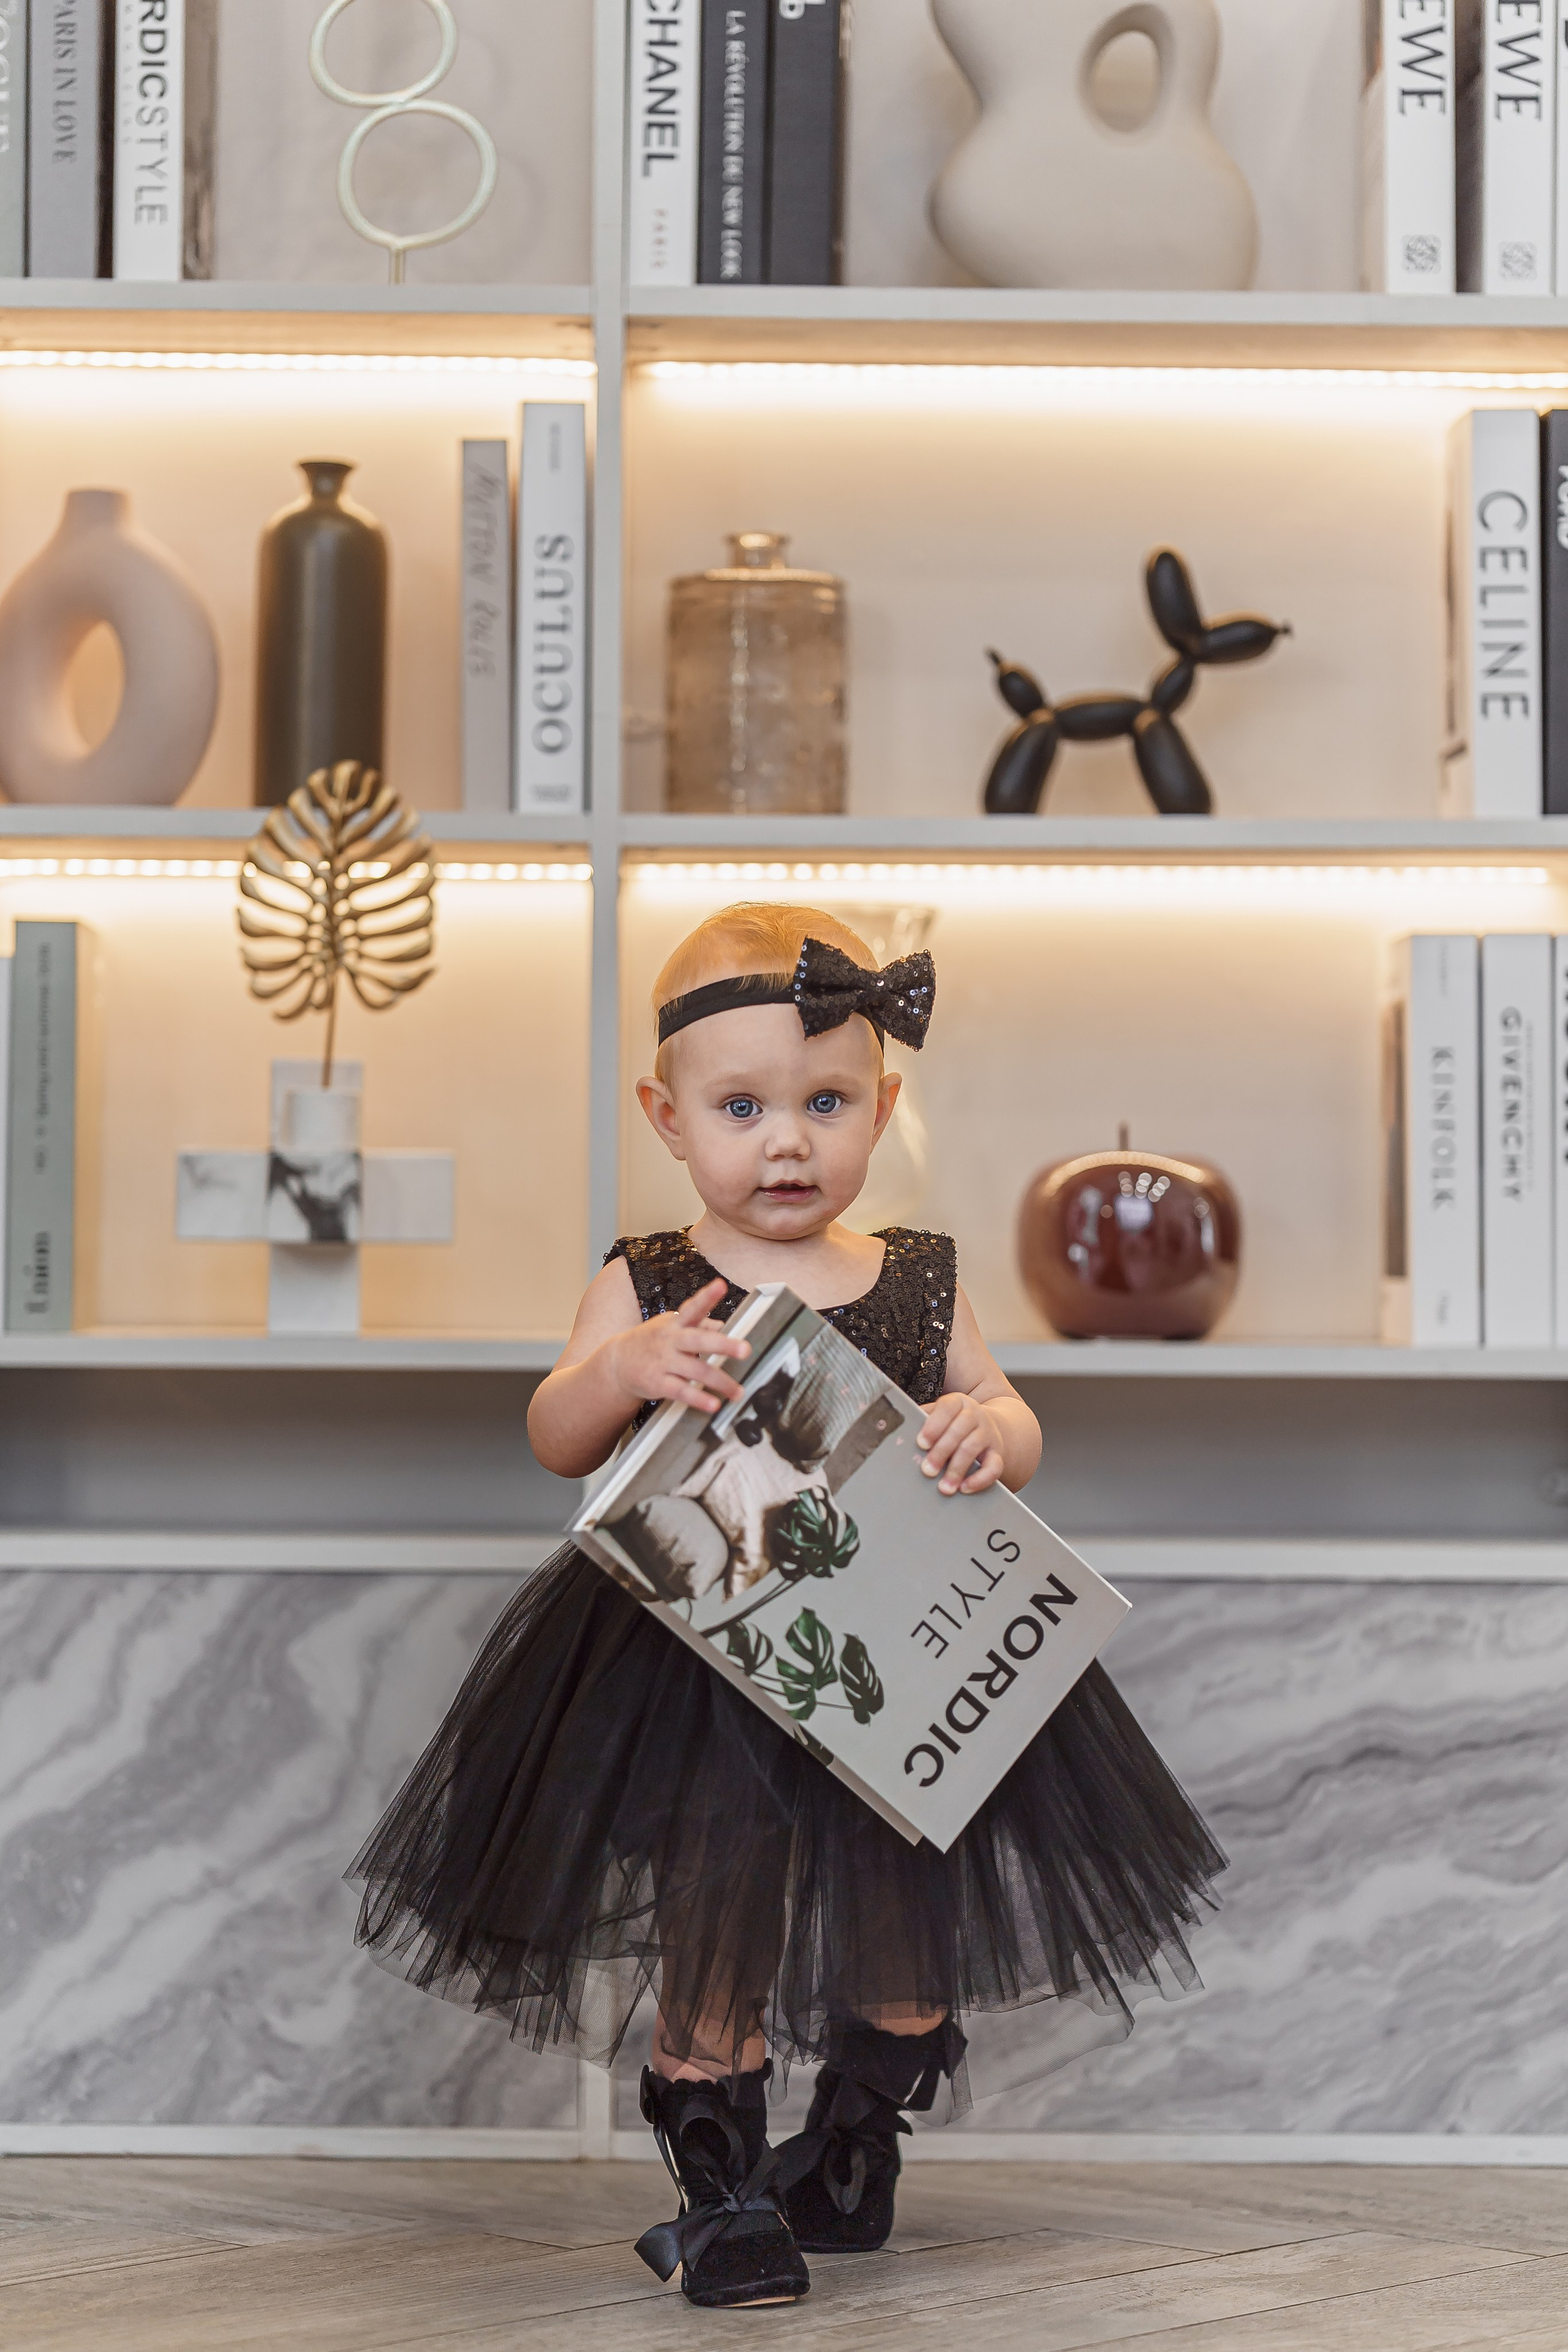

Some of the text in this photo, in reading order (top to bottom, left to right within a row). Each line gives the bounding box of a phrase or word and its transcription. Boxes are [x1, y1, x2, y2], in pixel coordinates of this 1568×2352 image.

[53, 67, 77, 92] IN
[726, 10, 747, 36] LA
[51, 99, 77, 164] LOVE
[531, 533, 575, 755] OCULUS
[1477, 490, 1530, 719] CELINE
[1499, 1006, 1523, 1203] GIVENCHY
[910, 1528, 1020, 1659] STYLE
[903, 1572, 1079, 1788] NORDIC
